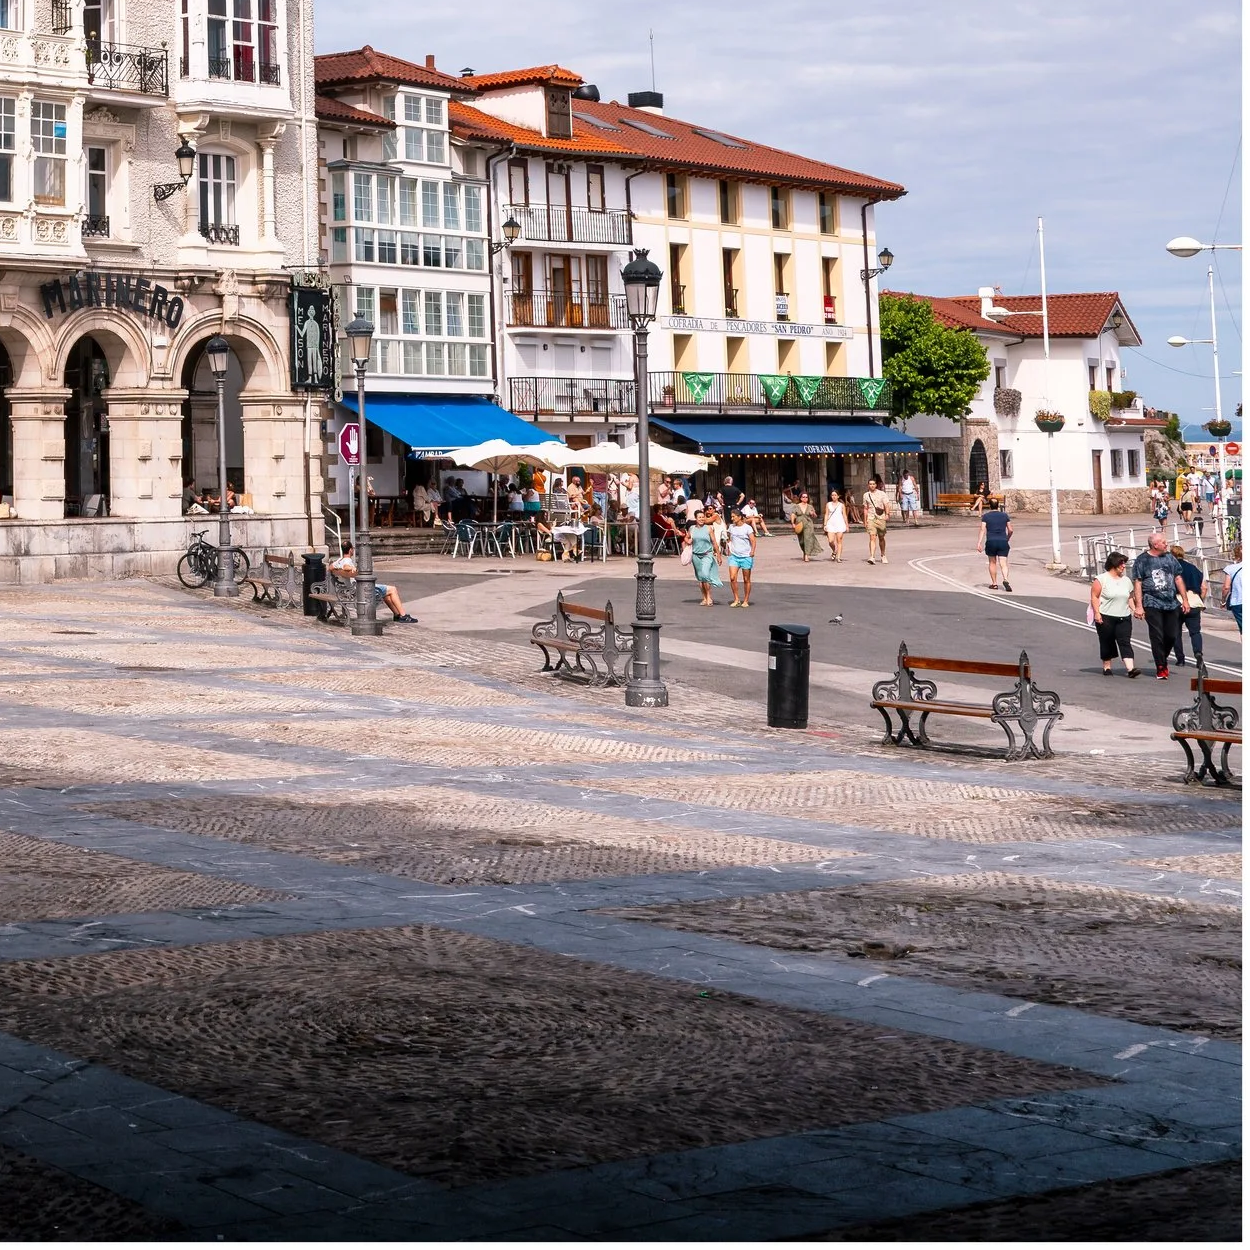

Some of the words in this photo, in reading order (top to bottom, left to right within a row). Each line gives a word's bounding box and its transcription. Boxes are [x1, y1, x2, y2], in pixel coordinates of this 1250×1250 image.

[293, 272, 331, 288] MESON
[40, 271, 184, 329] MARINERO
[710, 321, 718, 330] DE
[726, 321, 767, 333] PESCADORES
